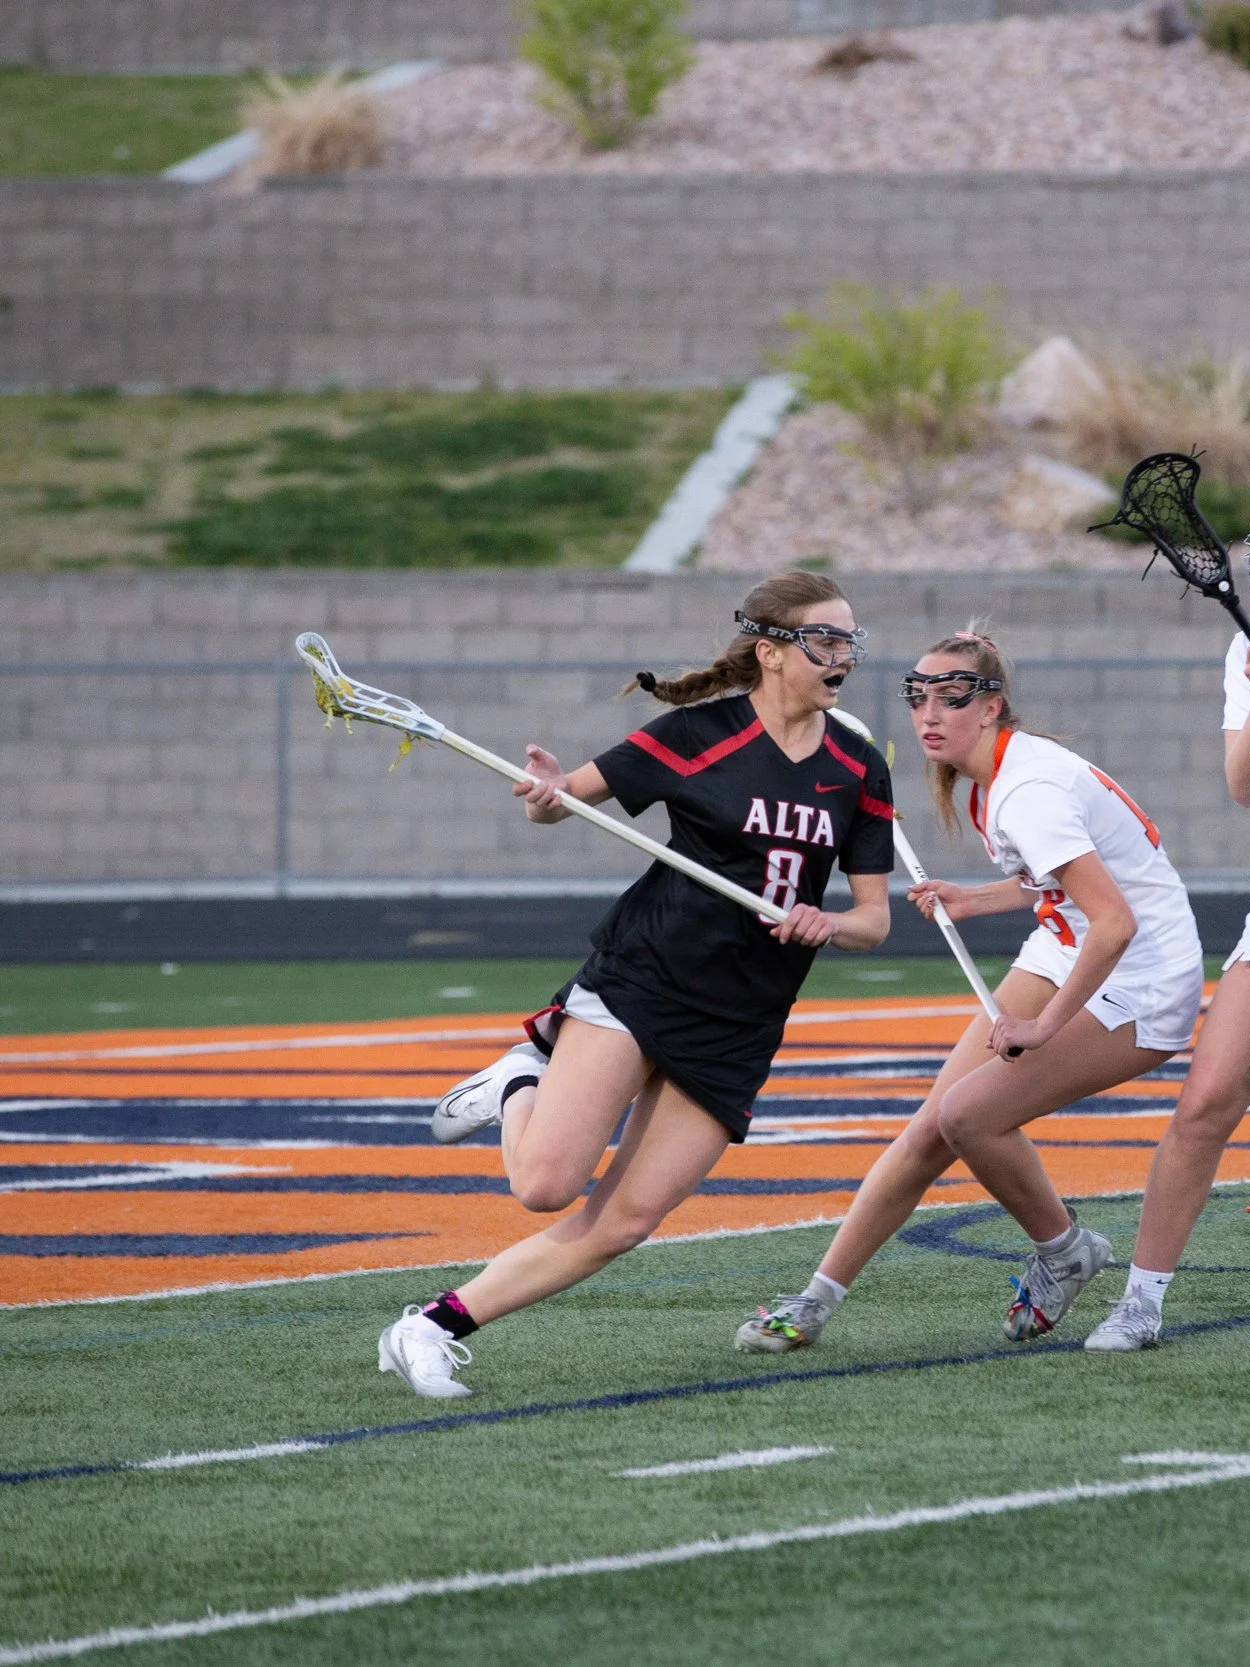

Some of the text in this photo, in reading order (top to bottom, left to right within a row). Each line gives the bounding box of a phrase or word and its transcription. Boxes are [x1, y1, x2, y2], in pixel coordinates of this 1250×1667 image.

[742, 617, 760, 633] STX
[767, 626, 797, 641] STX
[742, 797, 834, 848] ALTA
[757, 848, 805, 927] 8
